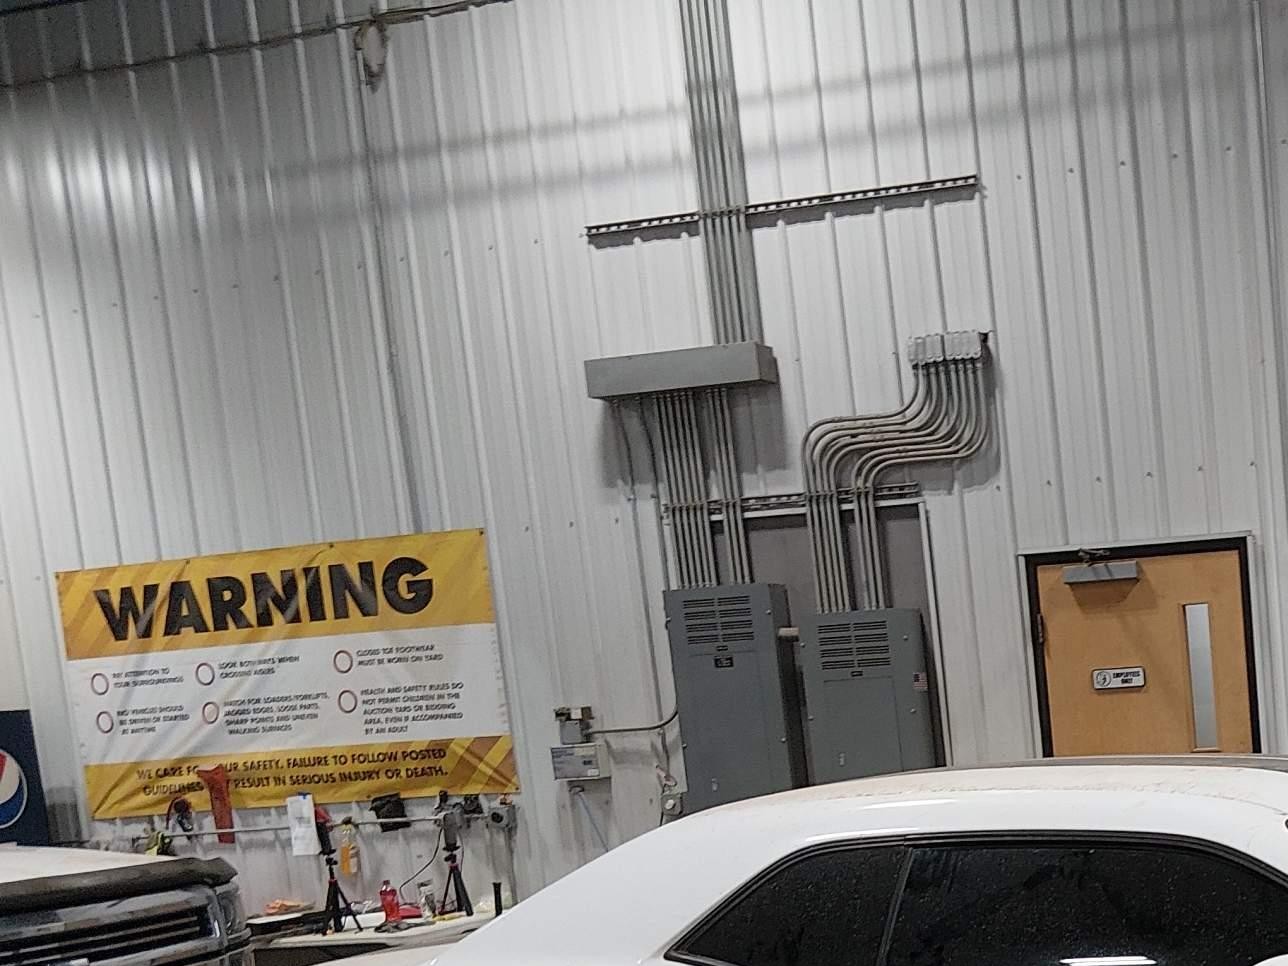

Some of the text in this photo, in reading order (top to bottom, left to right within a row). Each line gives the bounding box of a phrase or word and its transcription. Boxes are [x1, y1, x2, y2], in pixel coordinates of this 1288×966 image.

[93, 557, 433, 641] WARNING
[137, 766, 152, 779] WE
[153, 766, 184, 779] CARE
[187, 764, 201, 777] FO
[243, 757, 283, 772] SAFETY.
[287, 755, 329, 769] FAILURE
[334, 753, 348, 765] TO
[351, 751, 400, 763] FOLLOW
[403, 748, 447, 761] POSTED
[143, 779, 205, 796] GUIDELINES
[233, 774, 269, 789] RESULT
[272, 773, 286, 787] IN
[289, 770, 335, 786] SERIOUS
[338, 768, 380, 784] INJURY
[384, 767, 401, 781] OR
[404, 765, 448, 780] DEATH.
